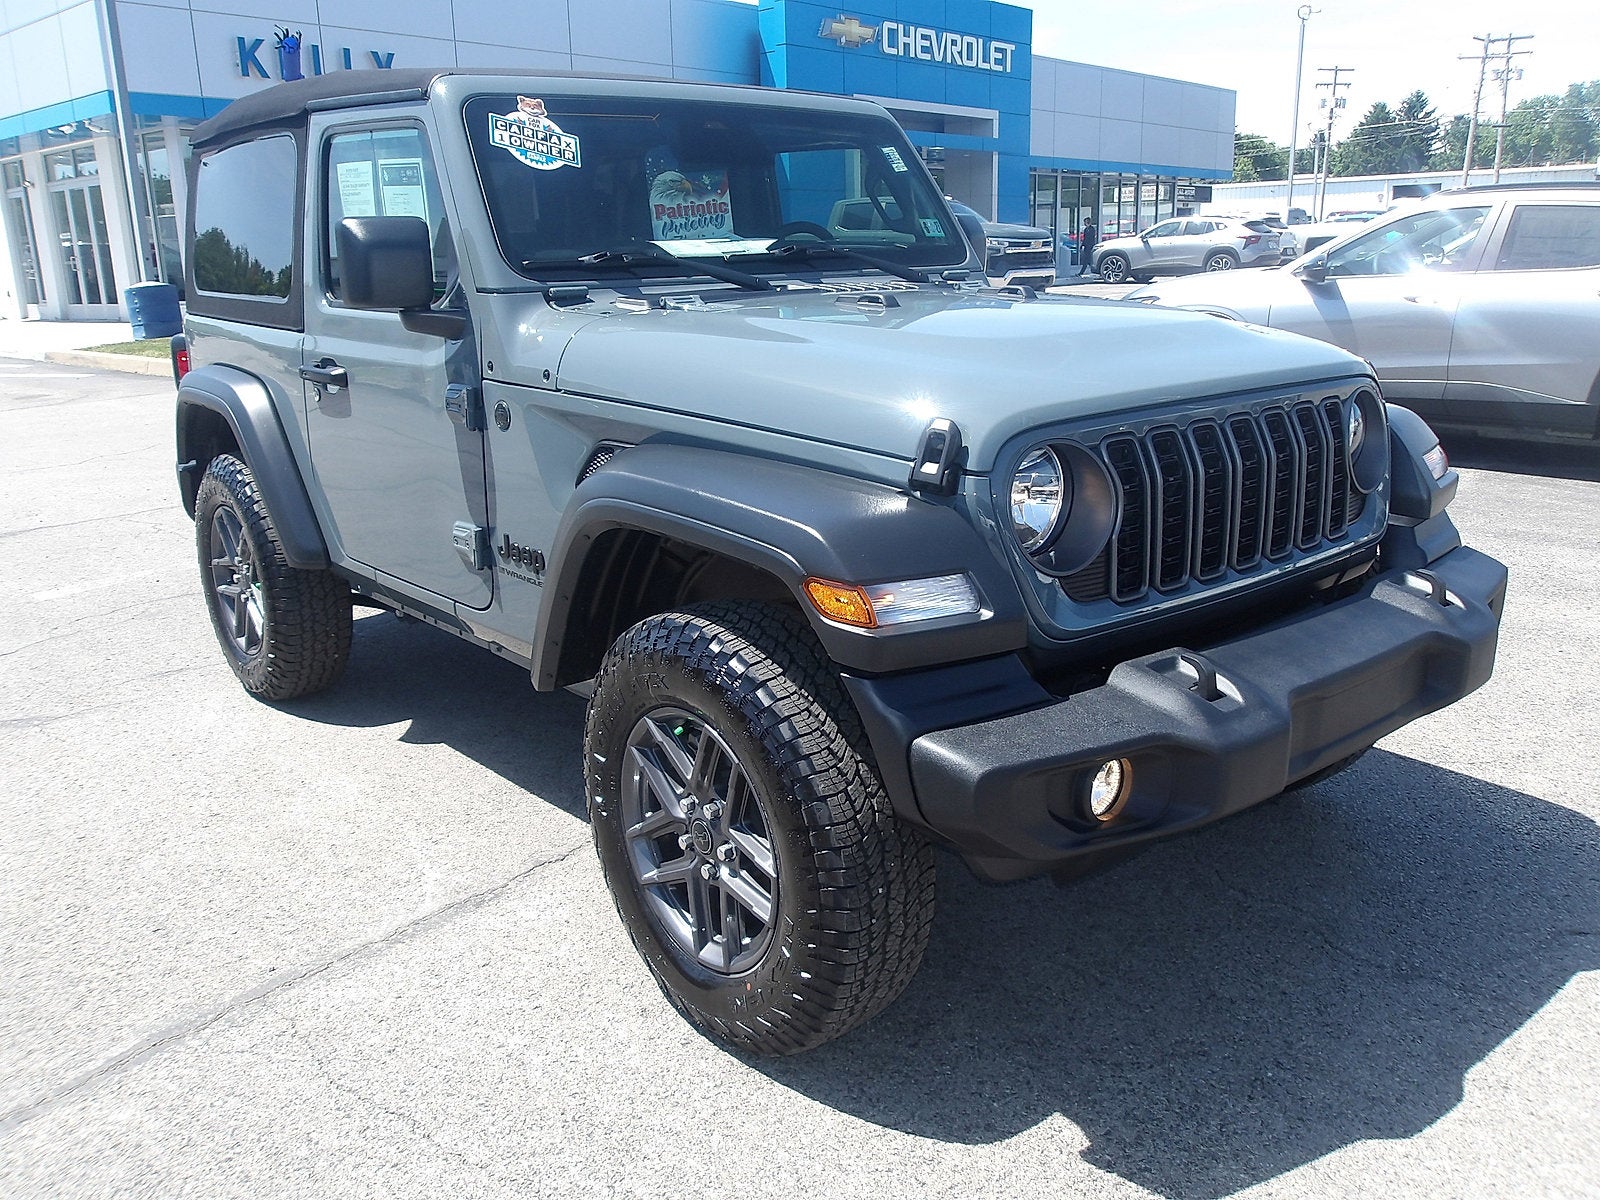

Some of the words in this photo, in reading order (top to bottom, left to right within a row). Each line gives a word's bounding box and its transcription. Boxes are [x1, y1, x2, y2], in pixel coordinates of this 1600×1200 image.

[882, 21, 1016, 73] CHEVROLET
[495, 119, 573, 150] CARFAX
[510, 135, 574, 161] OWNER
[653, 199, 730, 221] Patriotic
[497, 533, 546, 575] Jeep
[505, 568, 545, 588] WRANGLE
